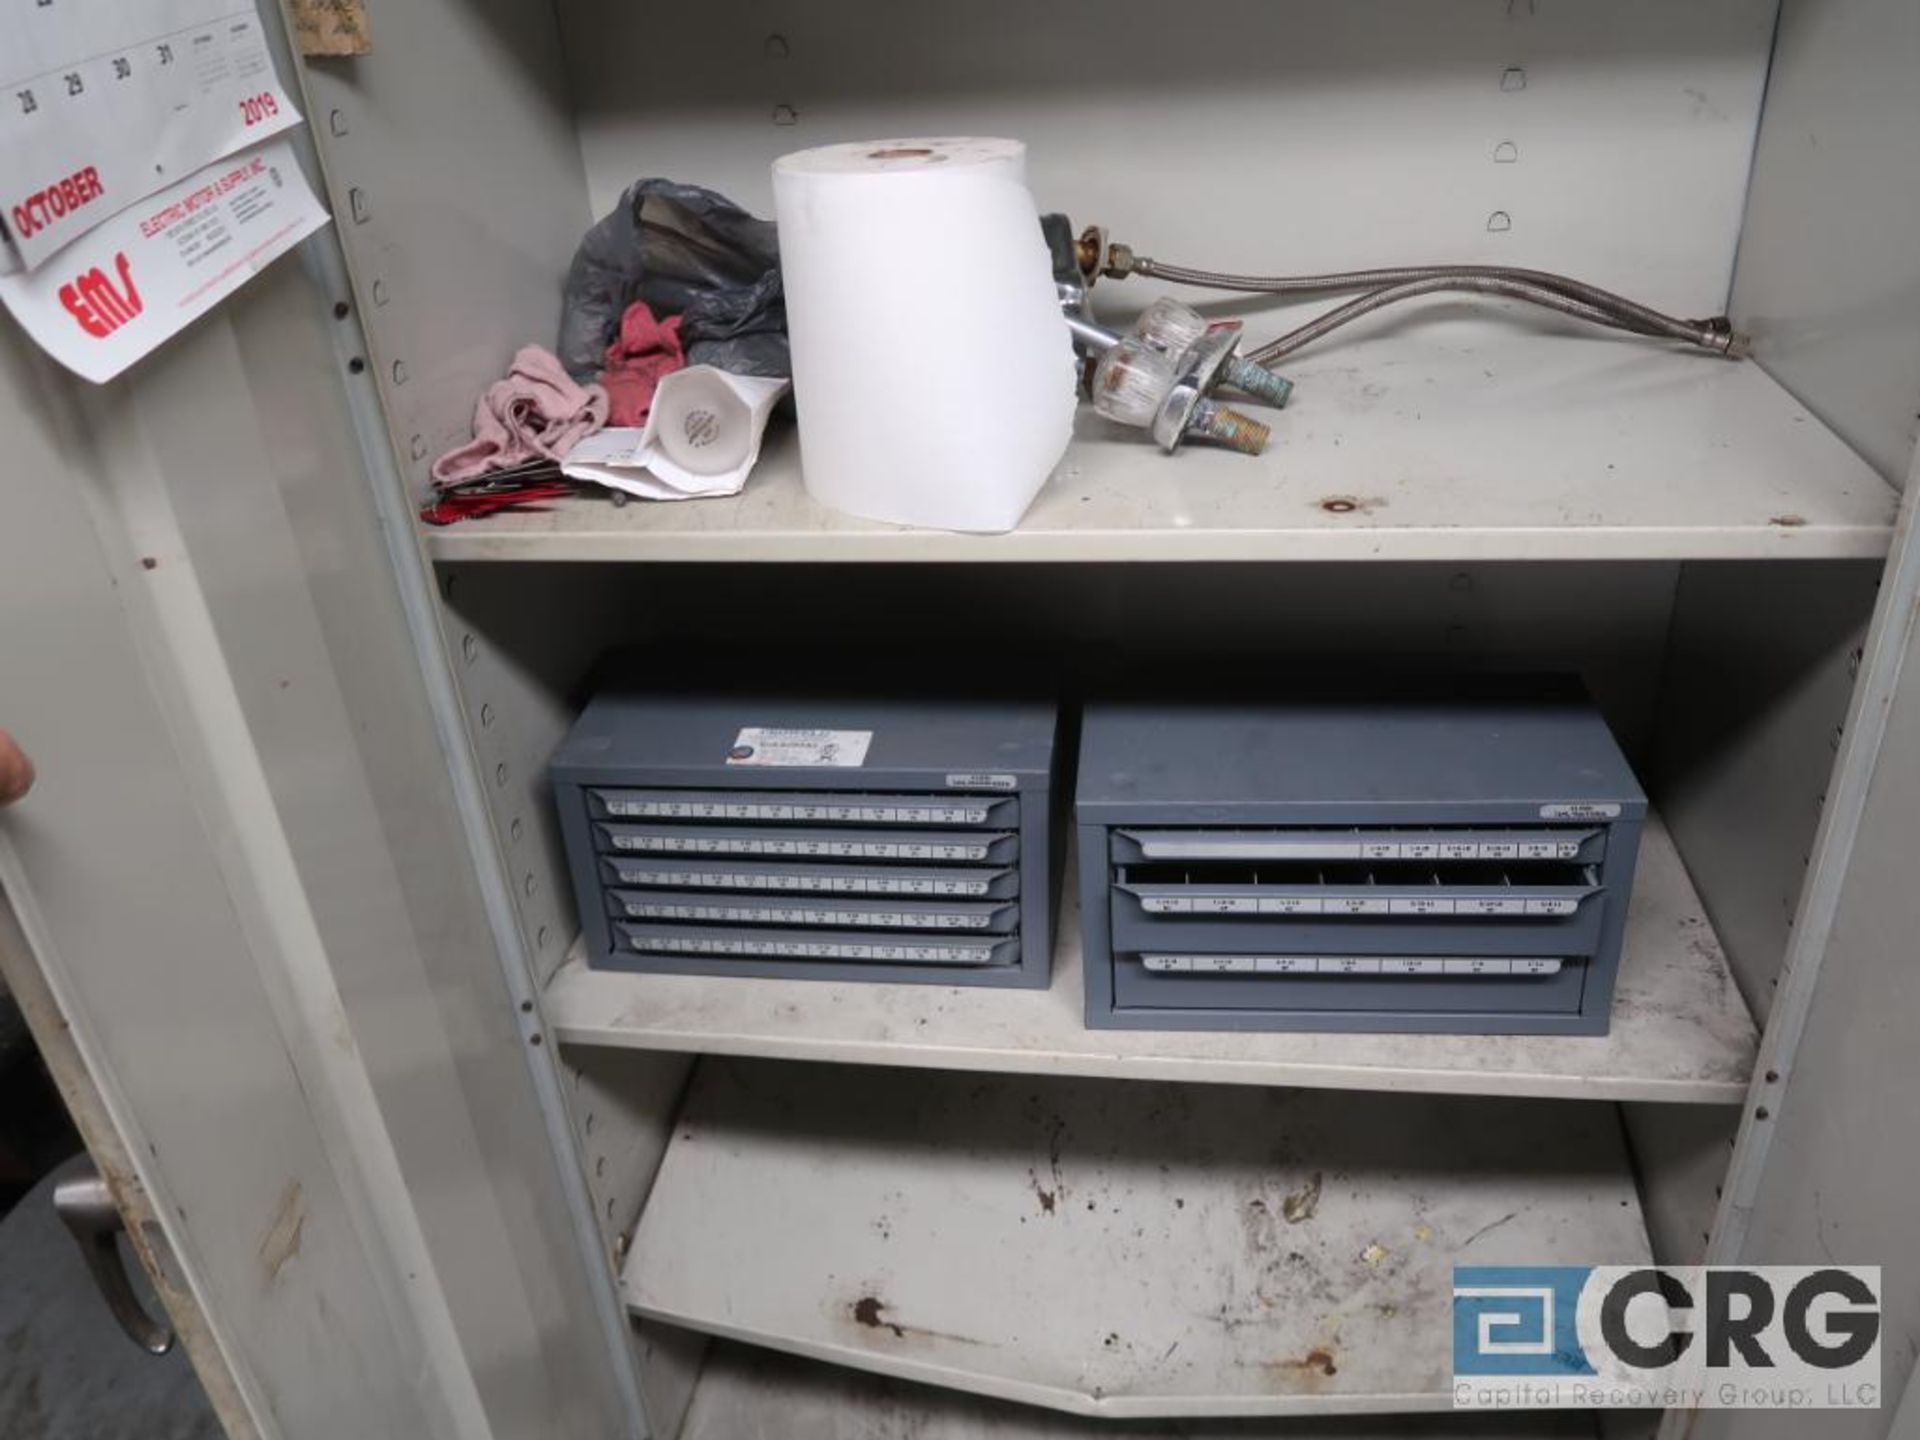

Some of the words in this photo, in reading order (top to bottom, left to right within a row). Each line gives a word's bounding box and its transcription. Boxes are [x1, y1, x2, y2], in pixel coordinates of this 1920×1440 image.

[17, 89, 38, 114] 28
[64, 72, 84, 96] 29
[112, 57, 131, 80] 30
[156, 44, 174, 66] 31
[239, 91, 279, 126] 2019
[12, 165, 104, 239] OCTOBER
[139, 202, 186, 239] ELECTRIC
[182, 185, 214, 212] MOTOR
[58, 251, 144, 339] EMS
